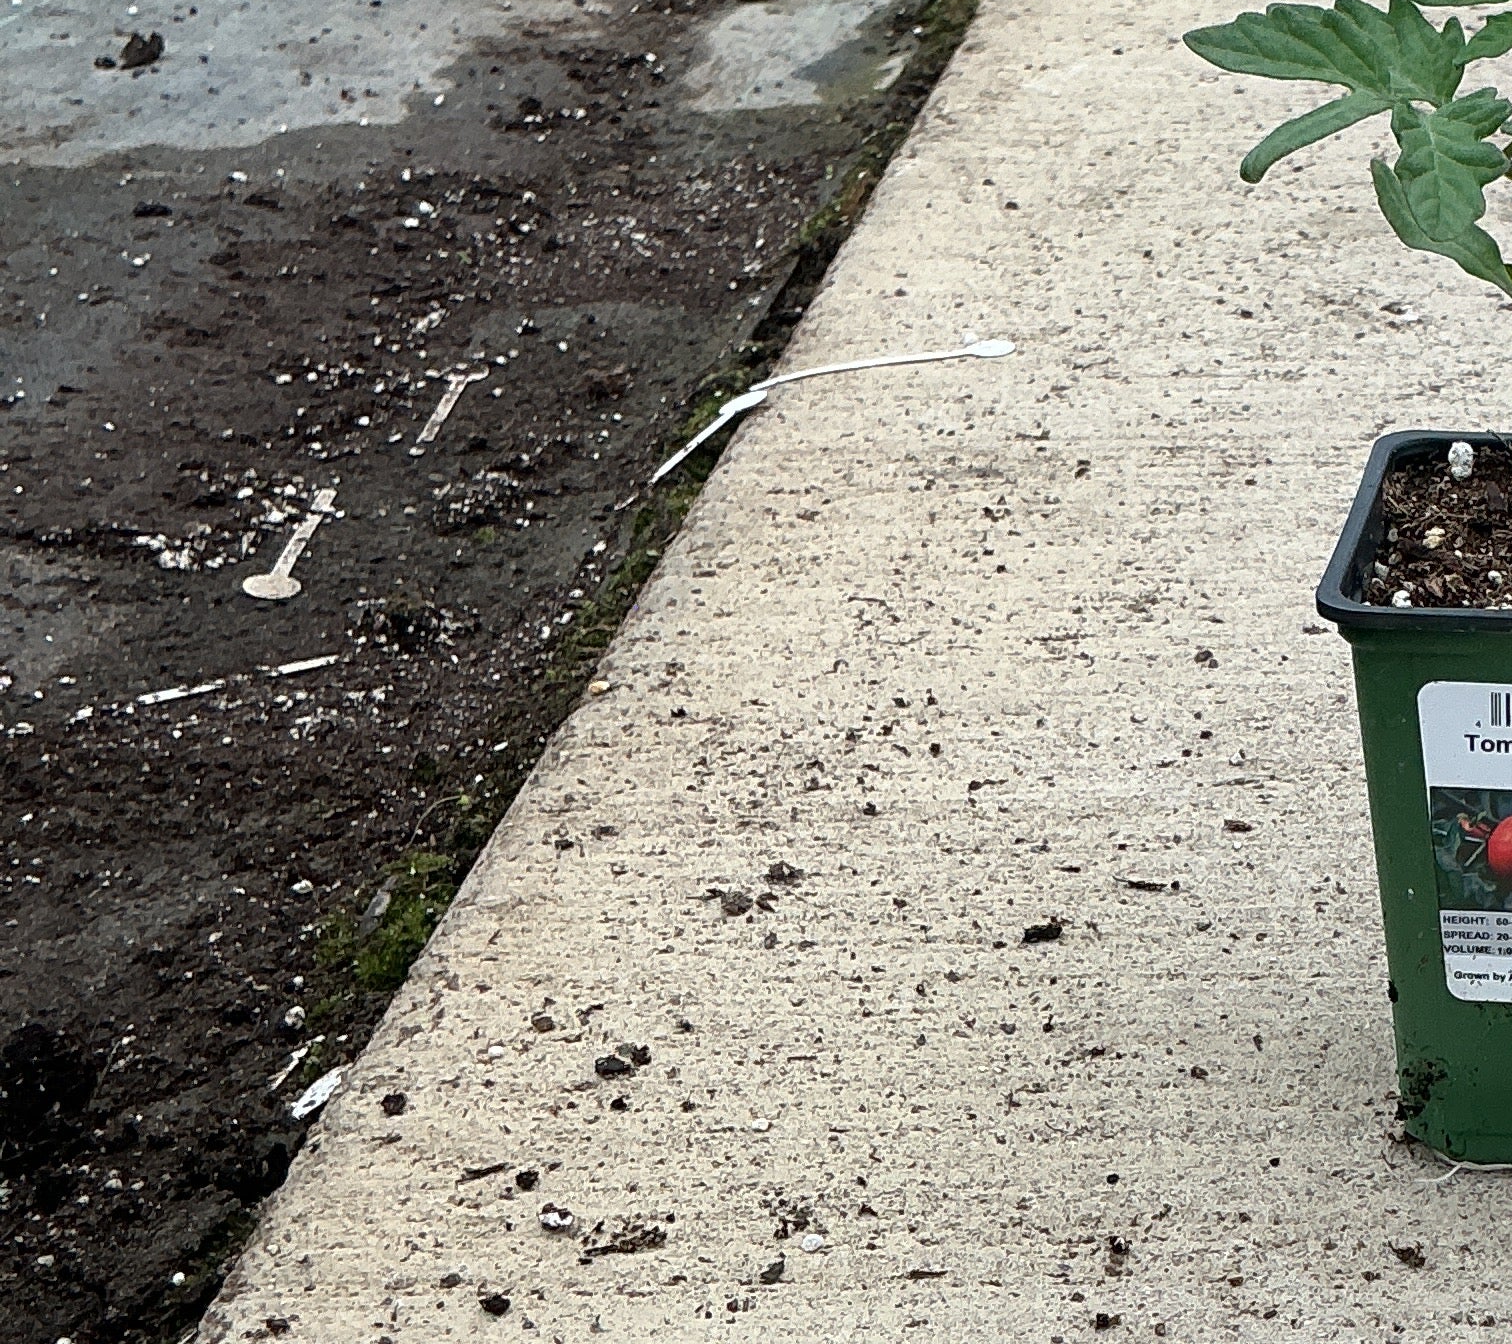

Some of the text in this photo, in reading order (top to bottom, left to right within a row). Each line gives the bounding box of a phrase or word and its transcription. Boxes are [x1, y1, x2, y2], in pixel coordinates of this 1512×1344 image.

[1443, 915, 1490, 926] HEIGHT:
[1443, 930, 1493, 941] SPREAD:
[1444, 944, 1496, 955] VOLUME:
[1454, 970, 1490, 981] Grown
[1493, 972, 1507, 984] by
